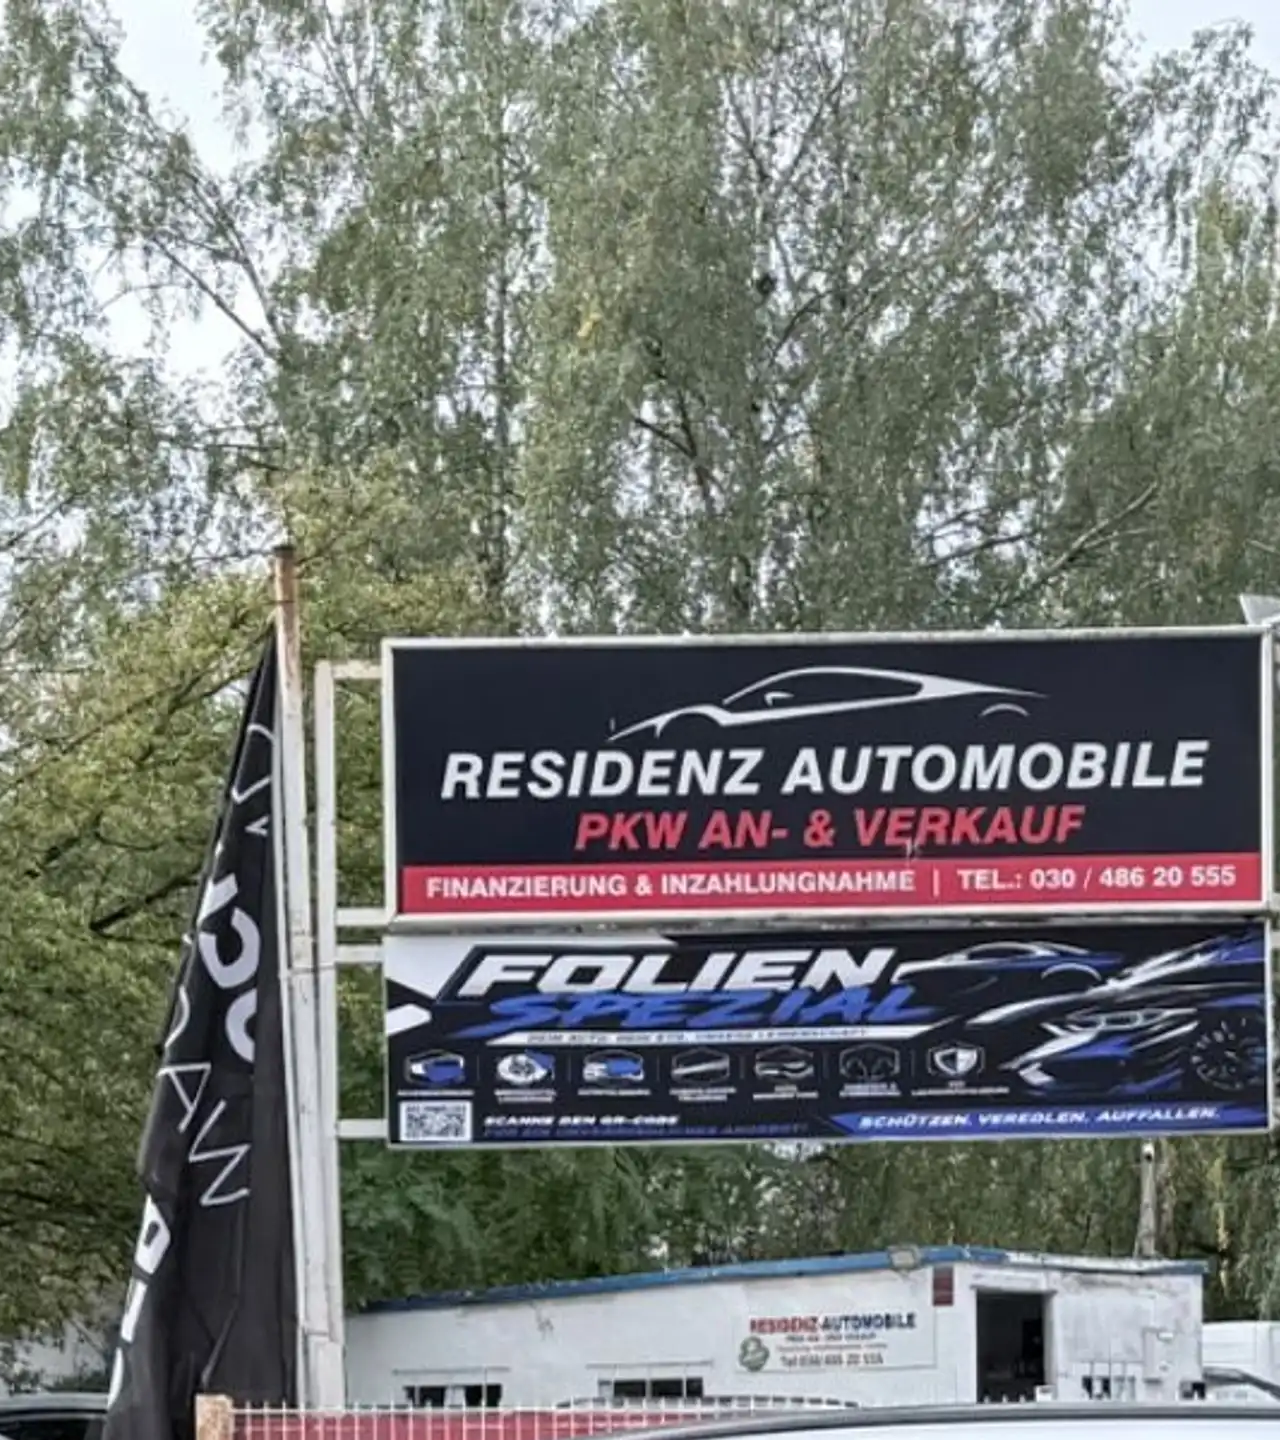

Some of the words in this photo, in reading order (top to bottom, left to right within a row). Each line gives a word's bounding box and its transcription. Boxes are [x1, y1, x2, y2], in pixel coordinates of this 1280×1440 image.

[440, 748, 764, 799] RESIDENZ
[780, 740, 1210, 793] AUTOMOBILE
[574, 810, 687, 851] PKW
[699, 808, 788, 848] AN-
[803, 808, 834, 845] &
[854, 804, 1086, 845] VERKAUF
[426, 873, 629, 899] FINANZIERUNG
[633, 873, 656, 895] &
[661, 870, 915, 896] INZAHLUNGNAHME
[957, 867, 1022, 891] TEL.:
[1029, 866, 1075, 890] 030
[1082, 865, 1093, 891] /
[1098, 864, 1148, 889] 486
[1153, 864, 1184, 888] 20
[1190, 863, 1237, 887] 555
[457, 948, 897, 998] FOLIEN
[450, 984, 940, 1038] SPEZIAL
[859, 1111, 972, 1129] SCHÜTZEN.
[1096, 1104, 1220, 1122] AUFFALLEN.
[821, 1312, 917, 1330] AUTOMOBILE
